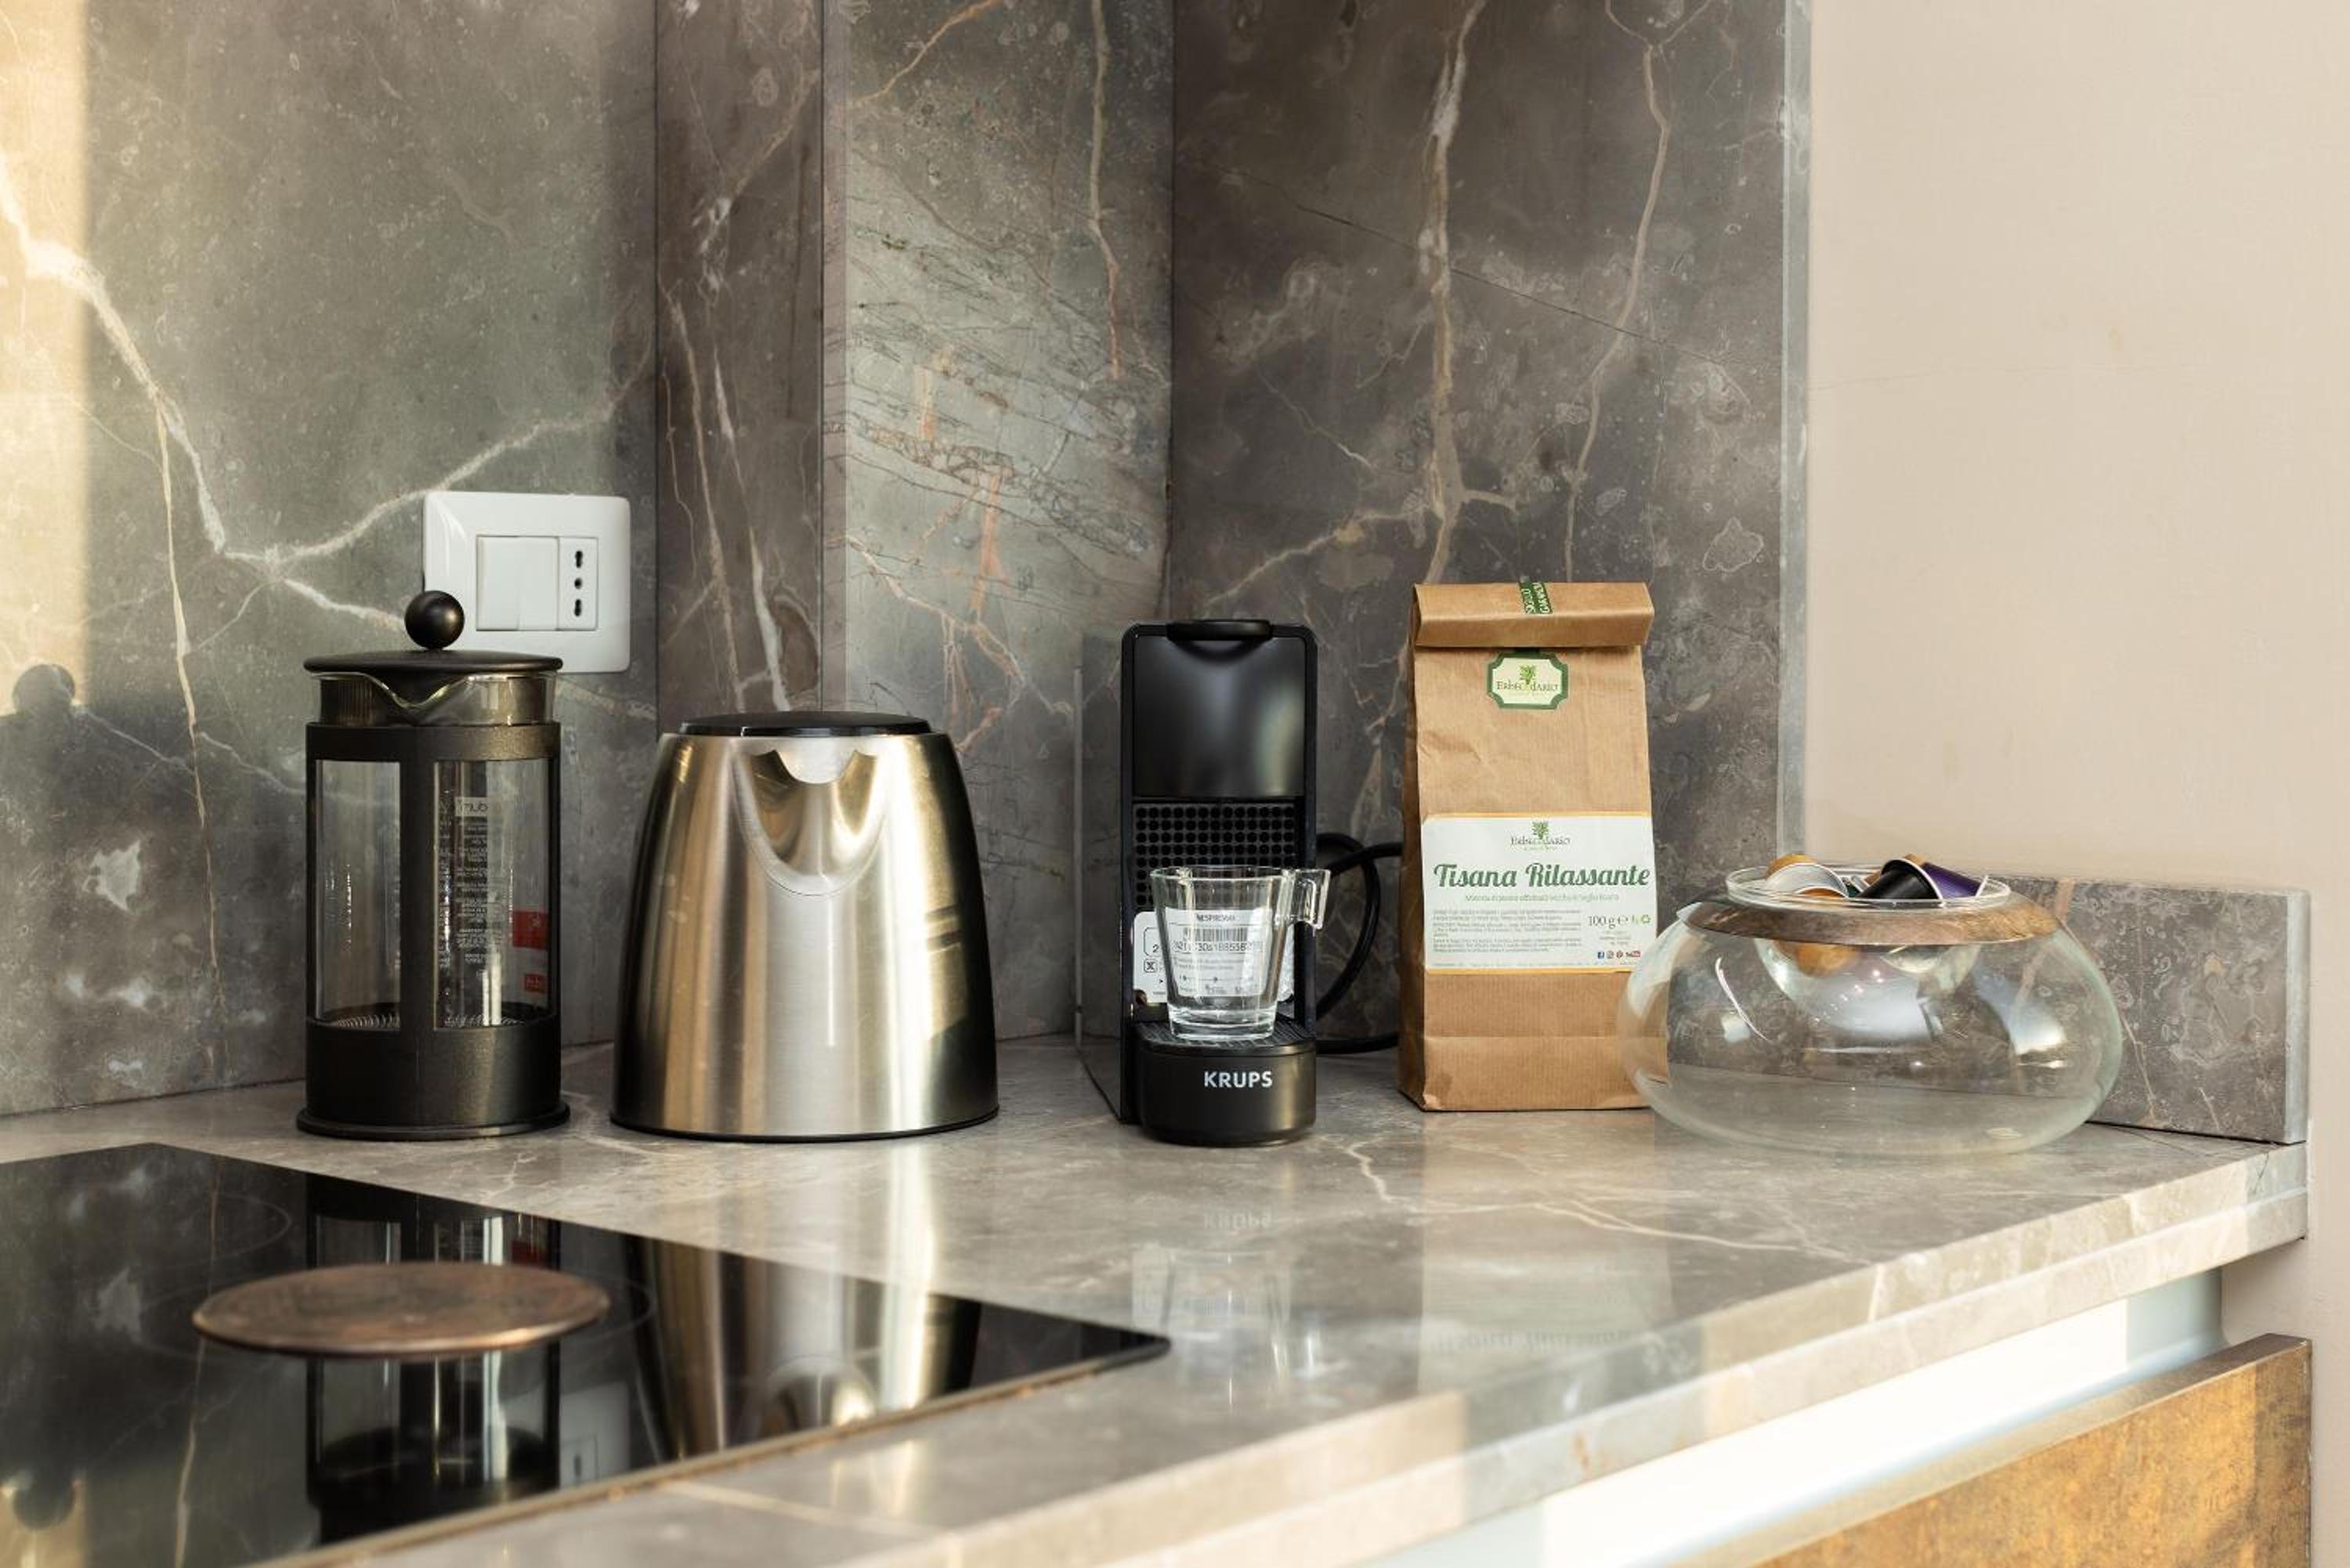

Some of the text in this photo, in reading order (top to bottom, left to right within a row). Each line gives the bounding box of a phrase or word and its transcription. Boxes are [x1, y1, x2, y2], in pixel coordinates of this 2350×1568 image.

[1433, 862, 1650, 887] Tisana Rilassante
[1588, 915, 1607, 927] 100
[1607, 916, 1616, 930] g
[1203, 1071, 1273, 1088] KRUPS
